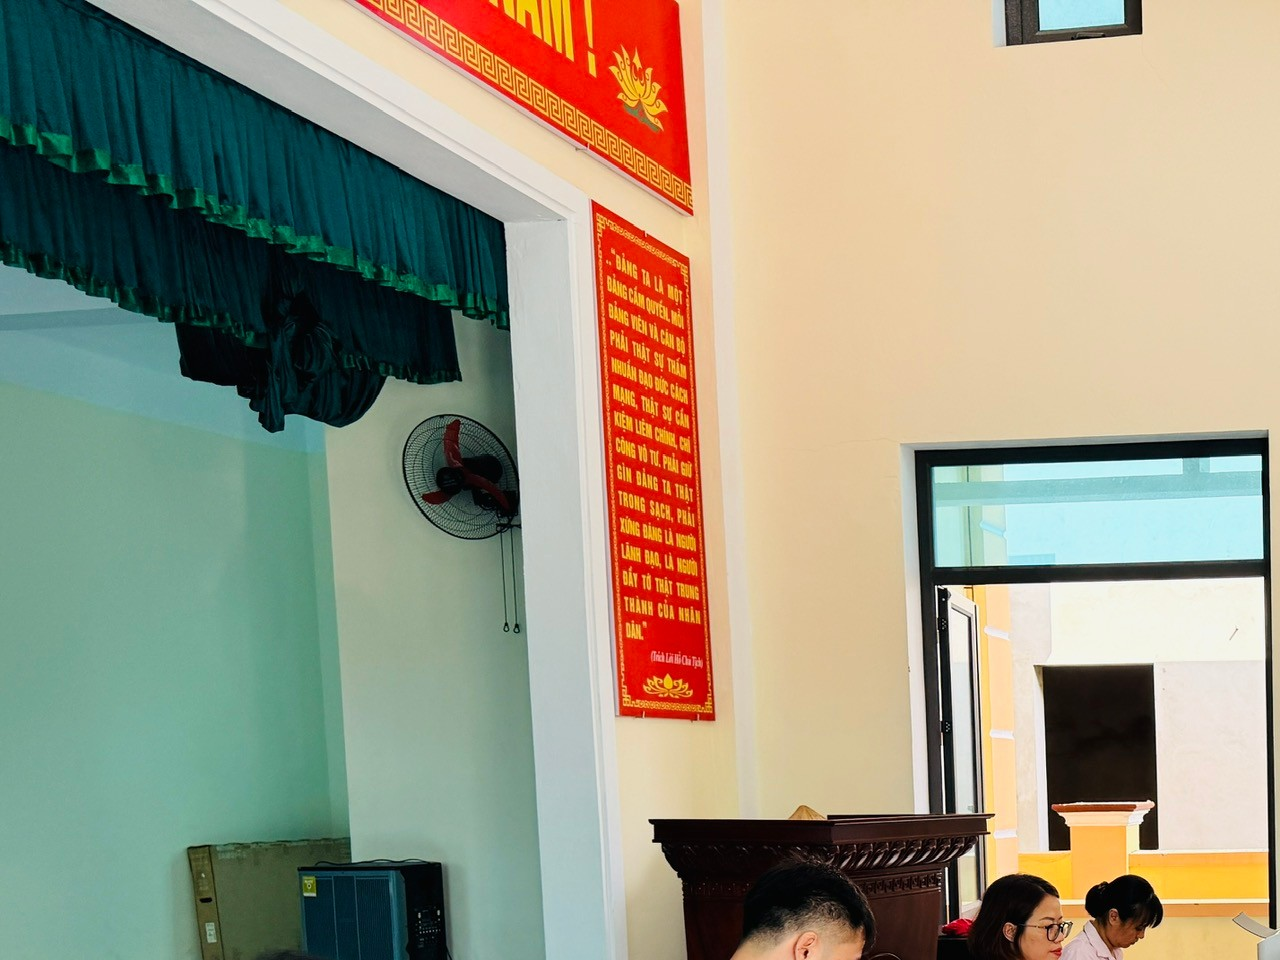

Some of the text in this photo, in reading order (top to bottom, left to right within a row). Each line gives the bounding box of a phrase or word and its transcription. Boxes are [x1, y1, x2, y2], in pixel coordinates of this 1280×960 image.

[606, 274, 628, 300] ĐẢNG
[641, 268, 651, 288] TA
[654, 275, 664, 295] LÀ
[667, 284, 683, 306] MỘT
[608, 301, 686, 358] ĐẢNG VIÊN VÀ CÁN BỘ
[610, 329, 629, 353] PHẢI
[632, 340, 650, 364] THẬT
[654, 351, 664, 372] SỰ
[612, 383, 638, 410] MẠNG,
[640, 395, 659, 418] THẬT
[662, 405, 672, 425] SỰ
[638, 369, 653, 390] ĐẠO
[654, 375, 669, 396] ĐỨC
[670, 382, 688, 405] CÁCH
[614, 410, 633, 432] KIỆM
[635, 418, 653, 439] LIÊM
[679, 436, 691, 454] CHÍ
[615, 436, 636, 459] CÔNG
[638, 444, 648, 463] VÔ
[662, 452, 679, 474] PHẢI
[681, 460, 692, 478] GIỮ
[617, 462, 693, 504] GÌN ĐẢNG TA THẬT
[618, 490, 695, 528] TRONG SẠCH, PHẢI
[620, 515, 697, 552] XỨNG ĐÁNG LÀ NGƯỜI
[621, 541, 641, 563] LÃNH
[664, 552, 674, 571] LÀ
[677, 557, 698, 577] NGƯỜI
[642, 573, 651, 591] TỚ
[655, 576, 673, 598] THẬT
[676, 582, 699, 601] TRUNG
[624, 595, 701, 625] THÀNH CỦA NHÂN
